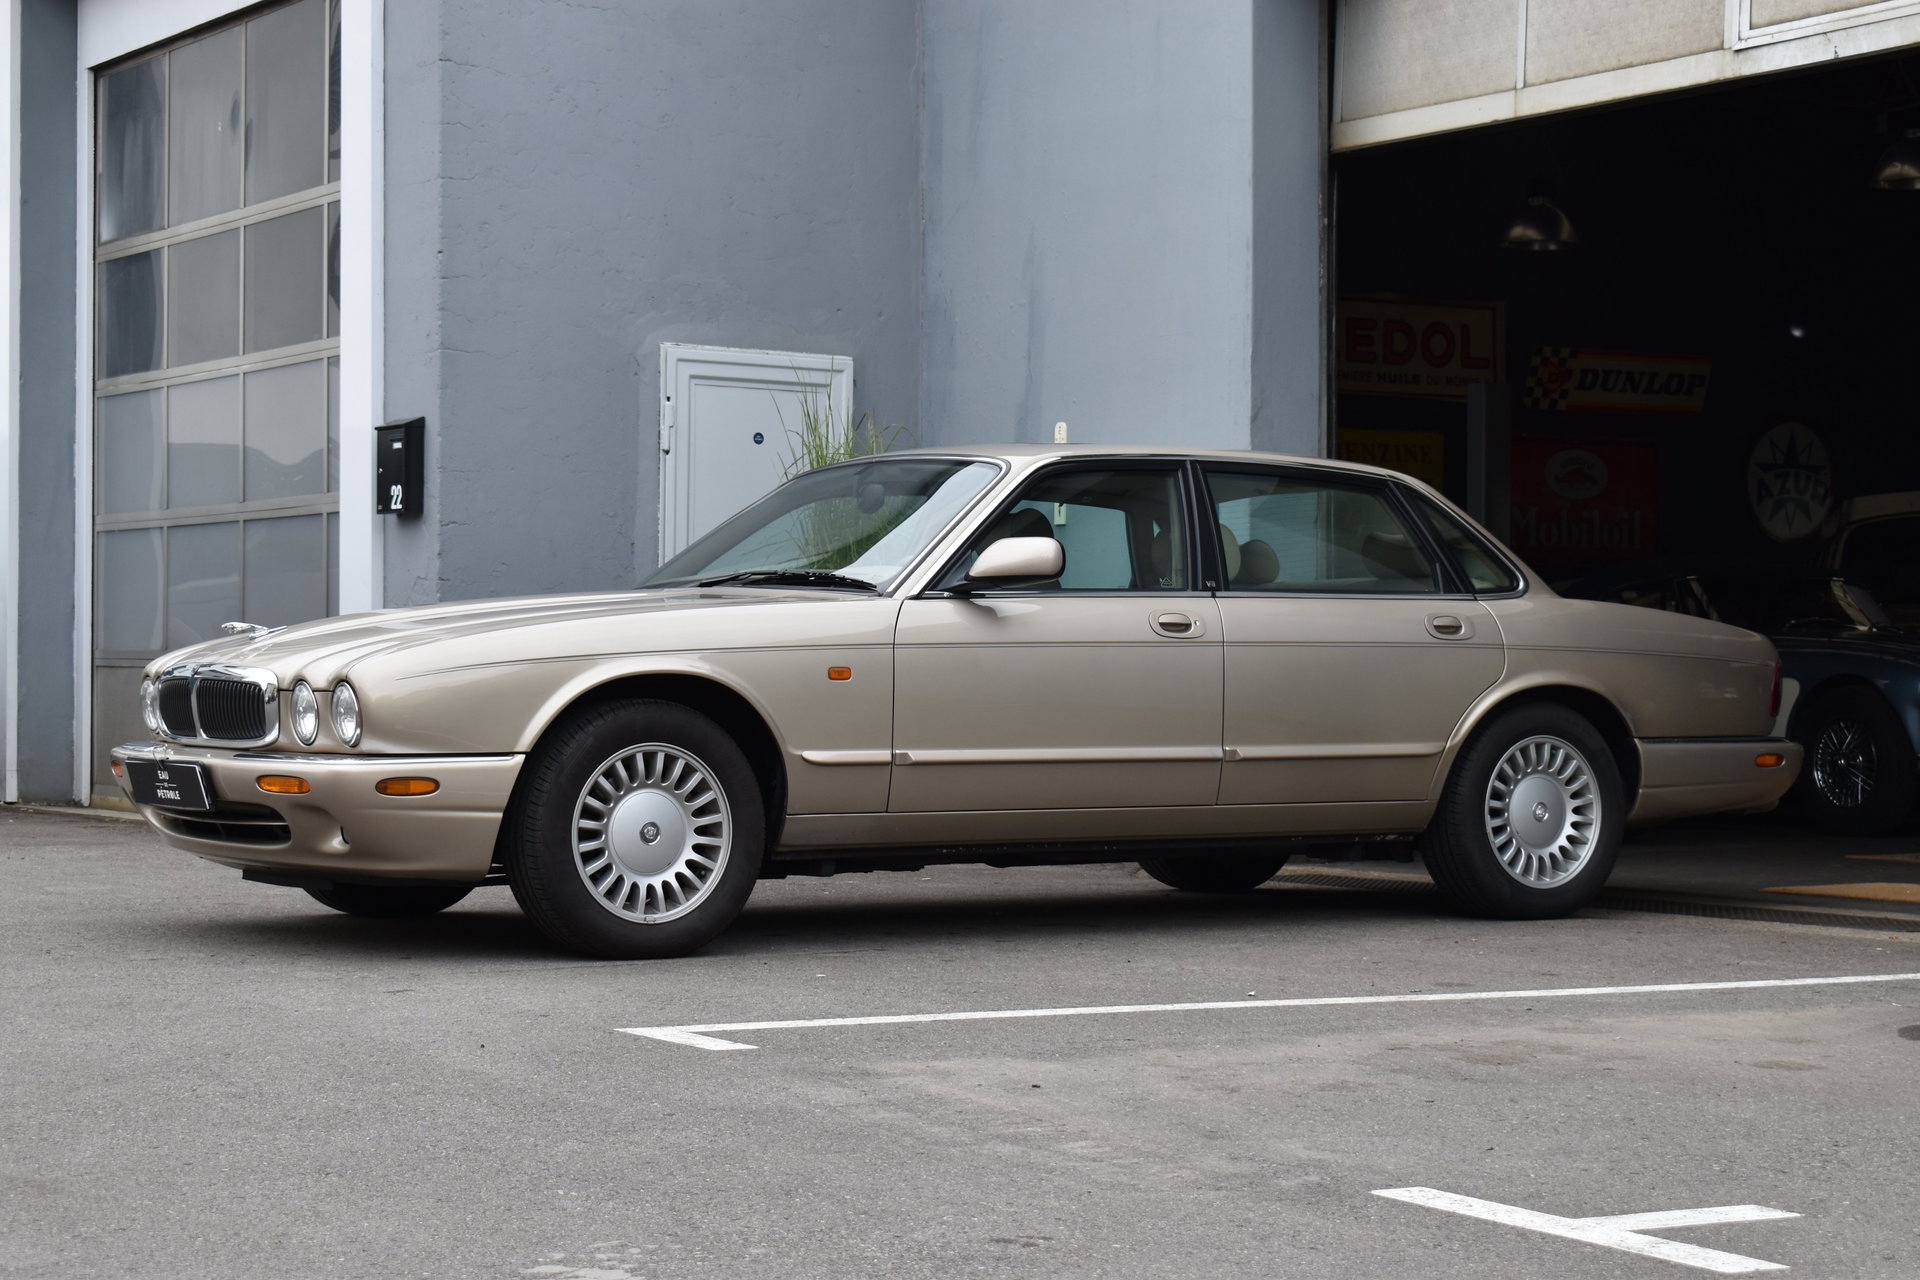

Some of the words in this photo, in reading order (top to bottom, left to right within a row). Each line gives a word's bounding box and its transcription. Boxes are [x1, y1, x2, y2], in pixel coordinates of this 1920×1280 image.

[1337, 317, 1490, 370] EDOL
[1376, 372, 1420, 385] HUILE
[1426, 375, 1441, 386] DU
[1574, 368, 1706, 396] DUNLOP
[390, 484, 402, 509] 22
[1756, 471, 1828, 507] AZUR
[1511, 506, 1641, 550] Mobiloil
[157, 770, 169, 780] EAU
